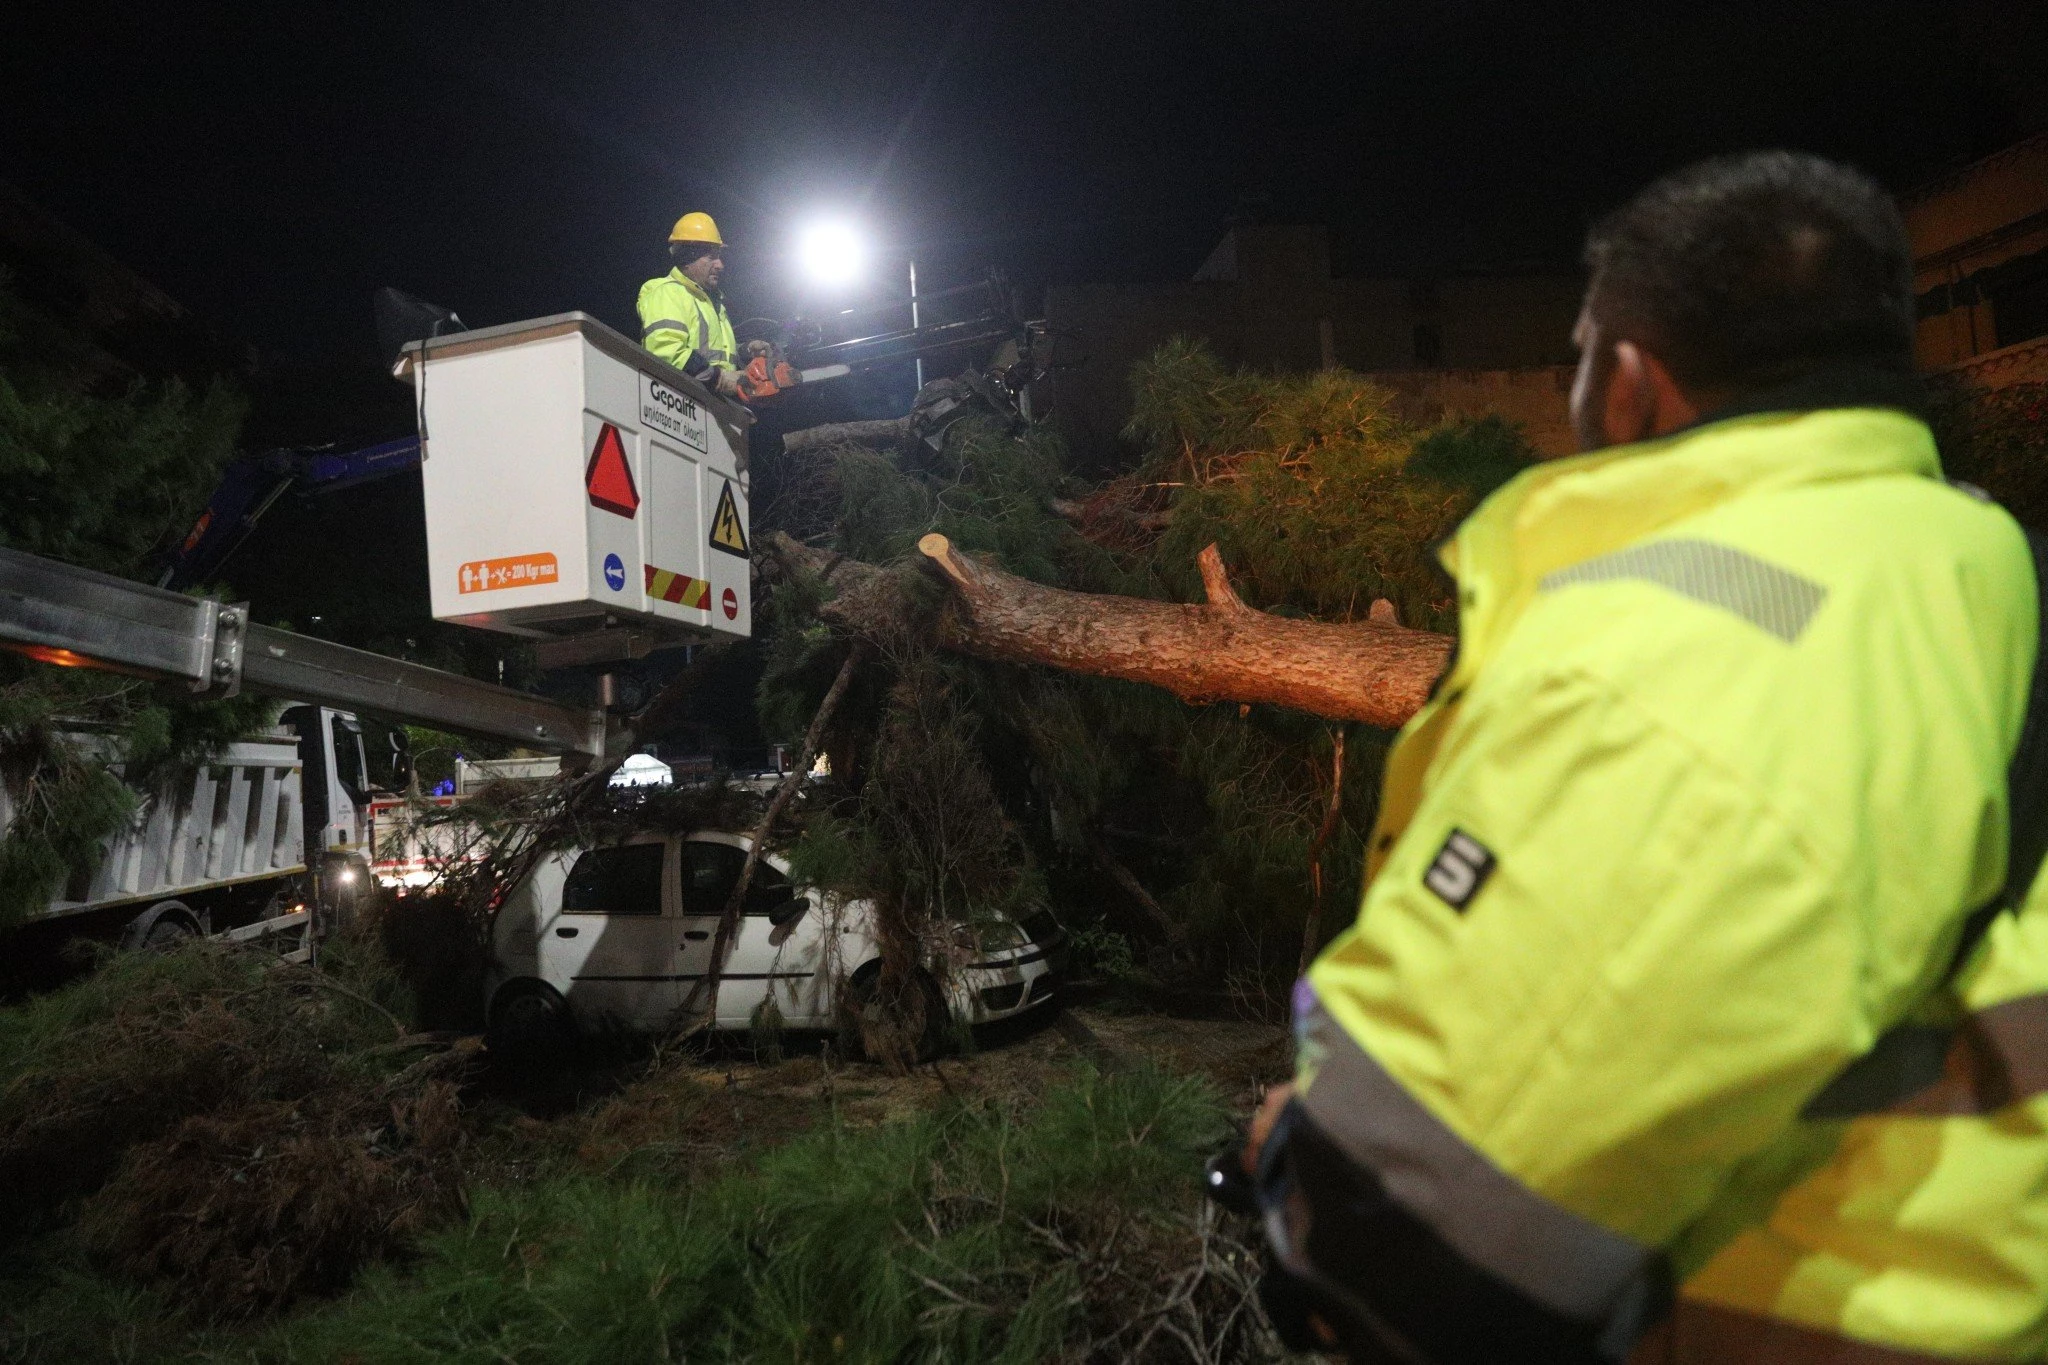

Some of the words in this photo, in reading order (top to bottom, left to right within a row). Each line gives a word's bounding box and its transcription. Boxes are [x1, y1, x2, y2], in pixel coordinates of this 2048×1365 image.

[650, 380, 697, 421] Gepalift
[512, 564, 525, 580] 200
[540, 564, 555, 575] max
